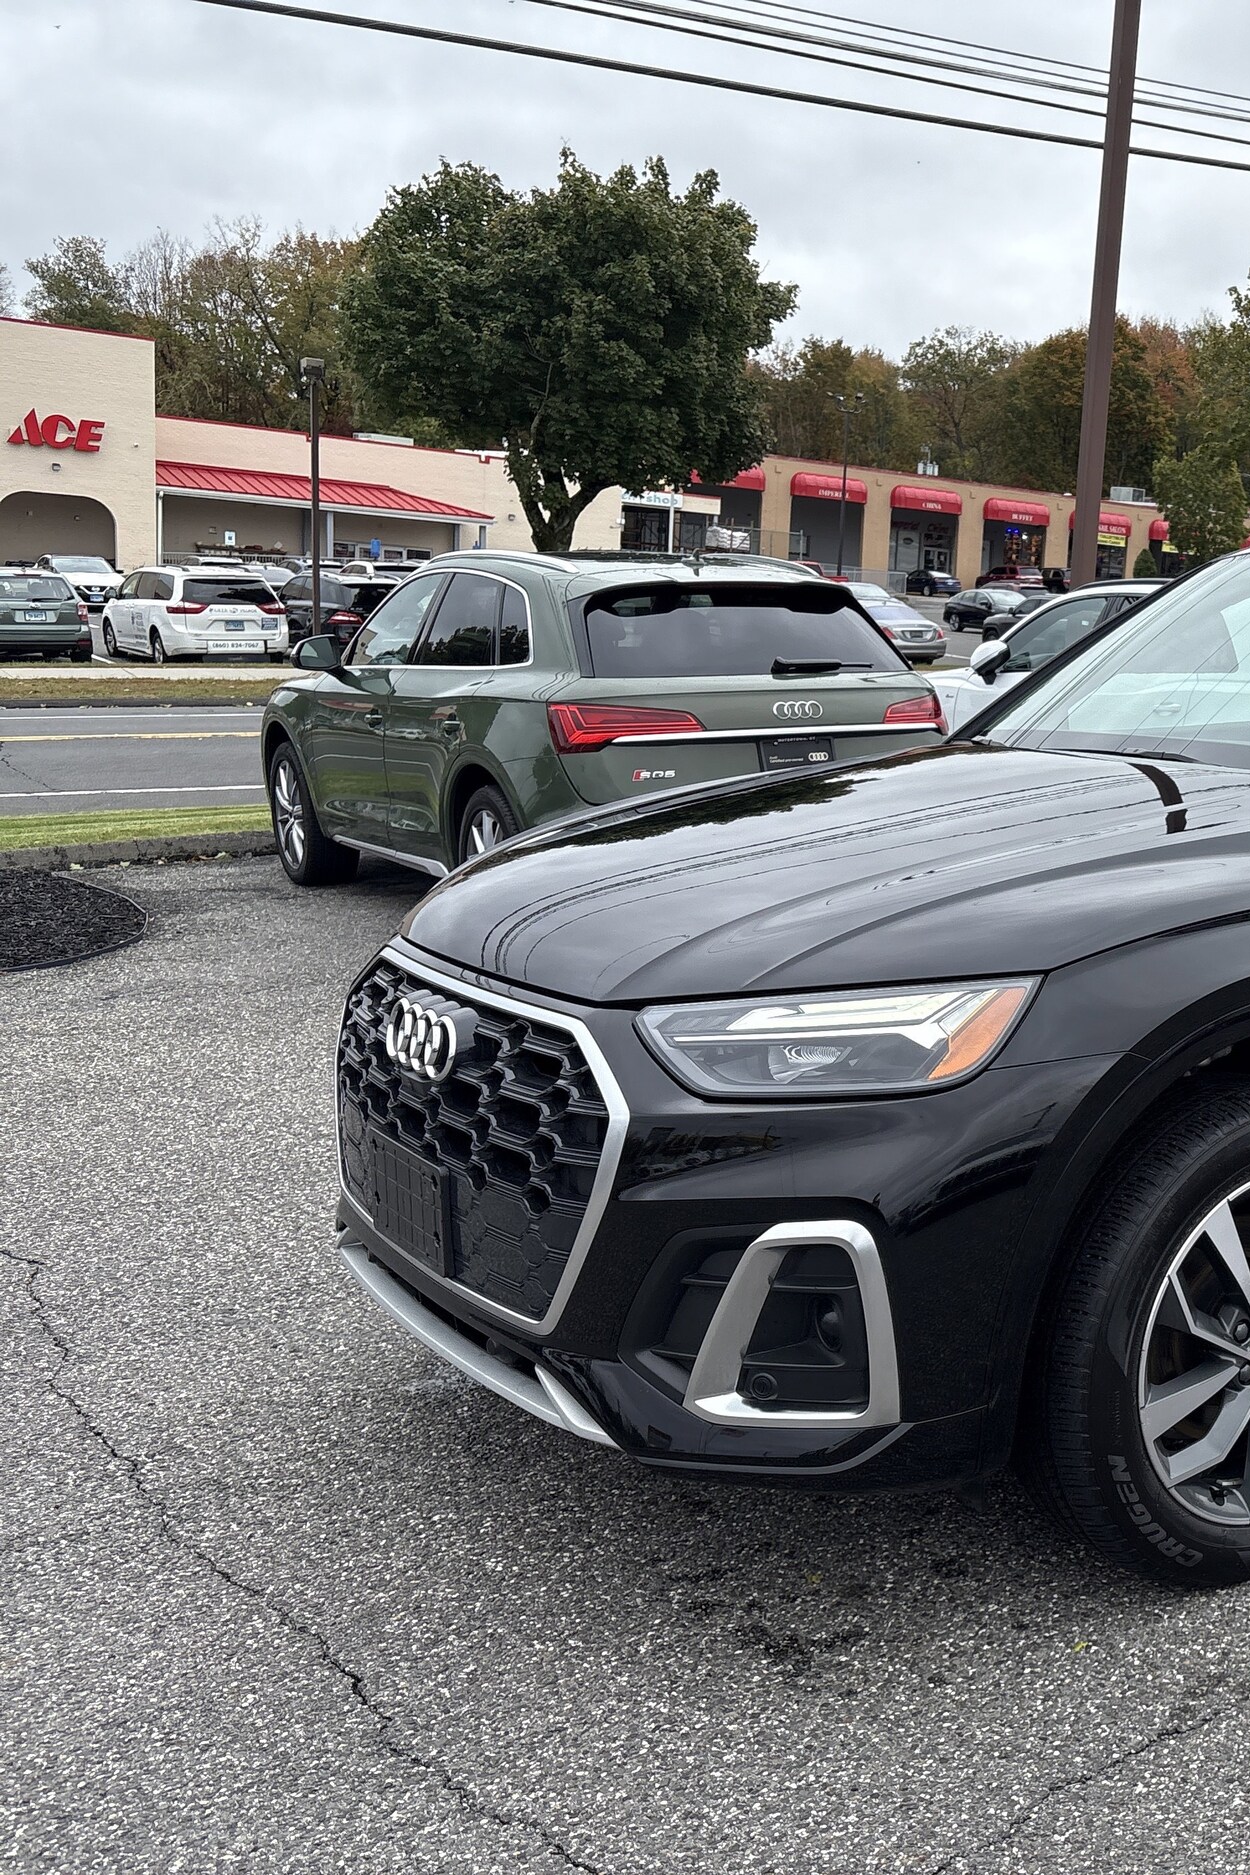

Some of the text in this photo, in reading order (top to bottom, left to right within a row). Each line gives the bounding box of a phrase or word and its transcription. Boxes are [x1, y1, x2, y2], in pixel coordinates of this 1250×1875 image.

[7, 407, 105, 452] ACE
[646, 494, 679, 505] shop
[818, 489, 849, 499] IMPERIL
[638, 769, 676, 780] SQ5
[1107, 1455, 1203, 1567] CRUGEN
